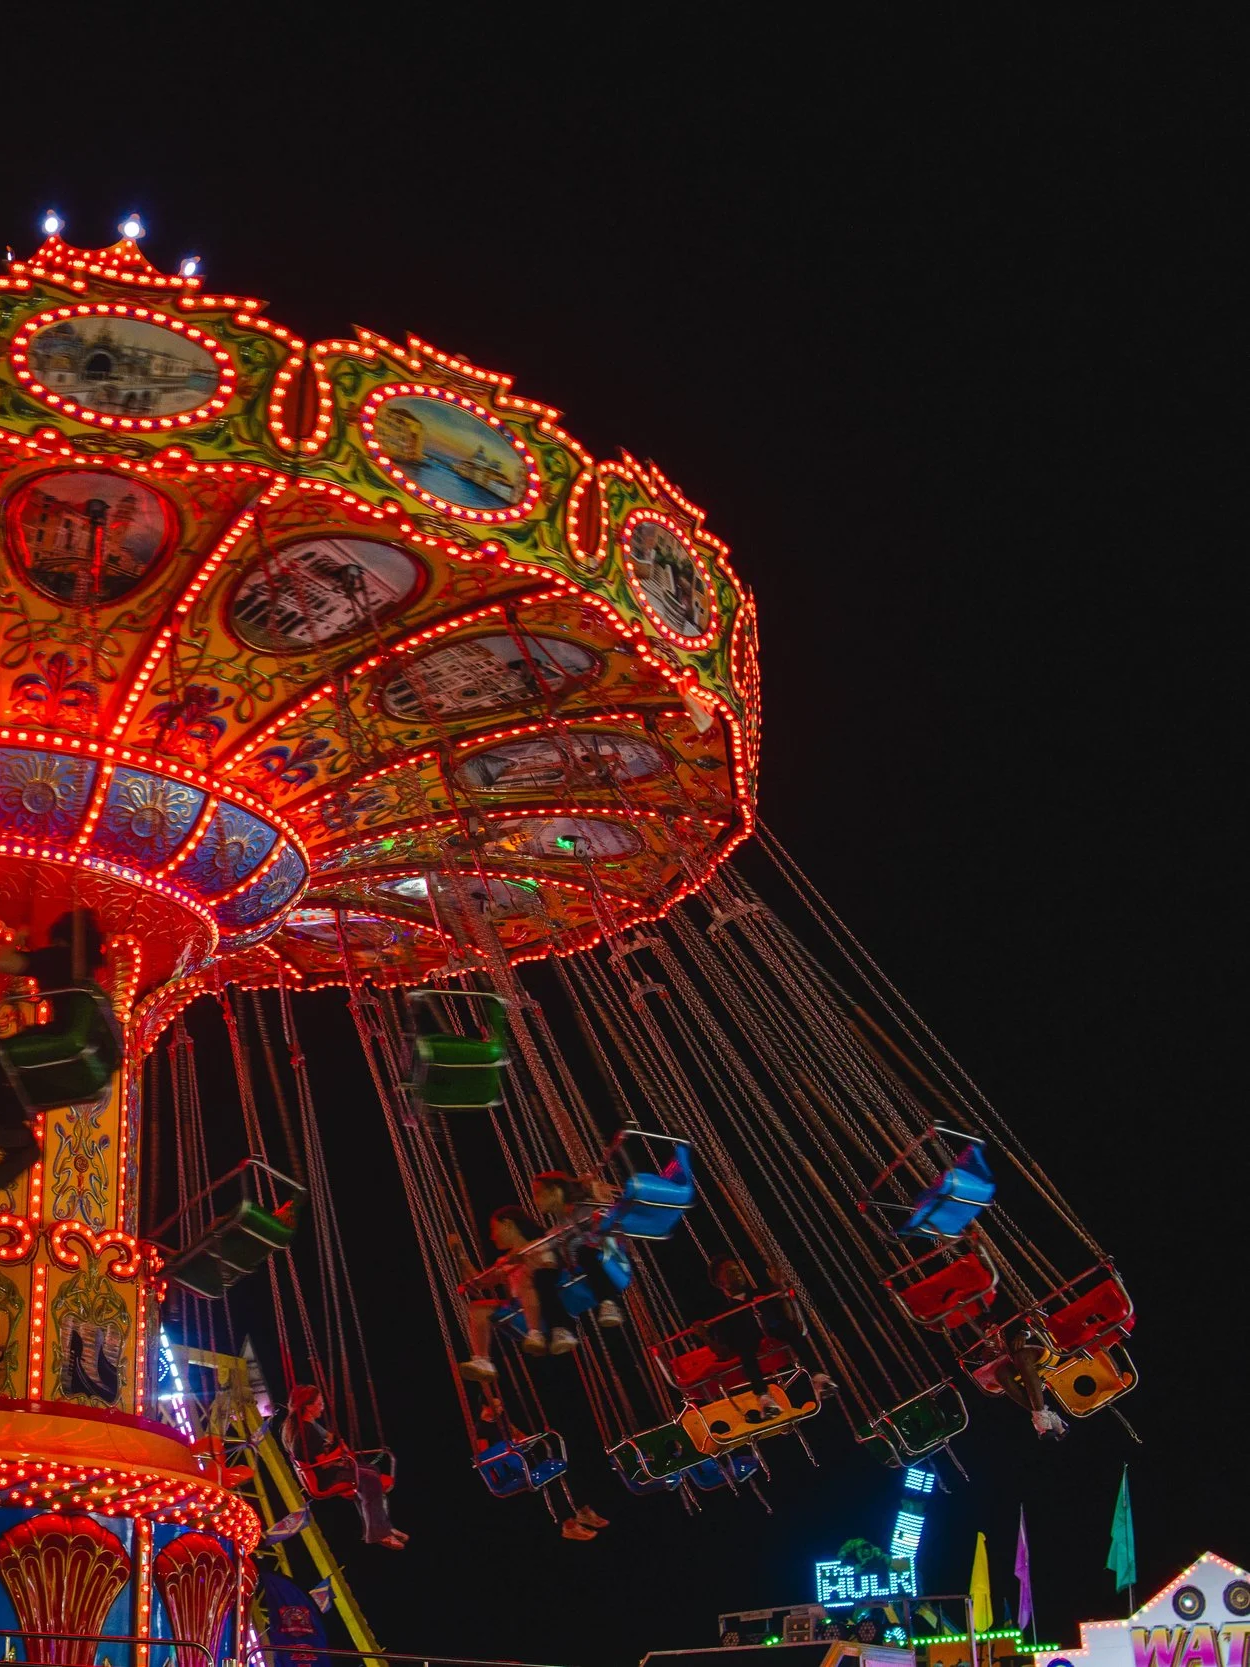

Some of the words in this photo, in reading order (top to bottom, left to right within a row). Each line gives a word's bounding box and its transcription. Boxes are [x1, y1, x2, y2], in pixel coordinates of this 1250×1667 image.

[822, 1565, 854, 1577] The
[822, 1571, 912, 1601] HULK
[1131, 1622, 1250, 1667] WAT
